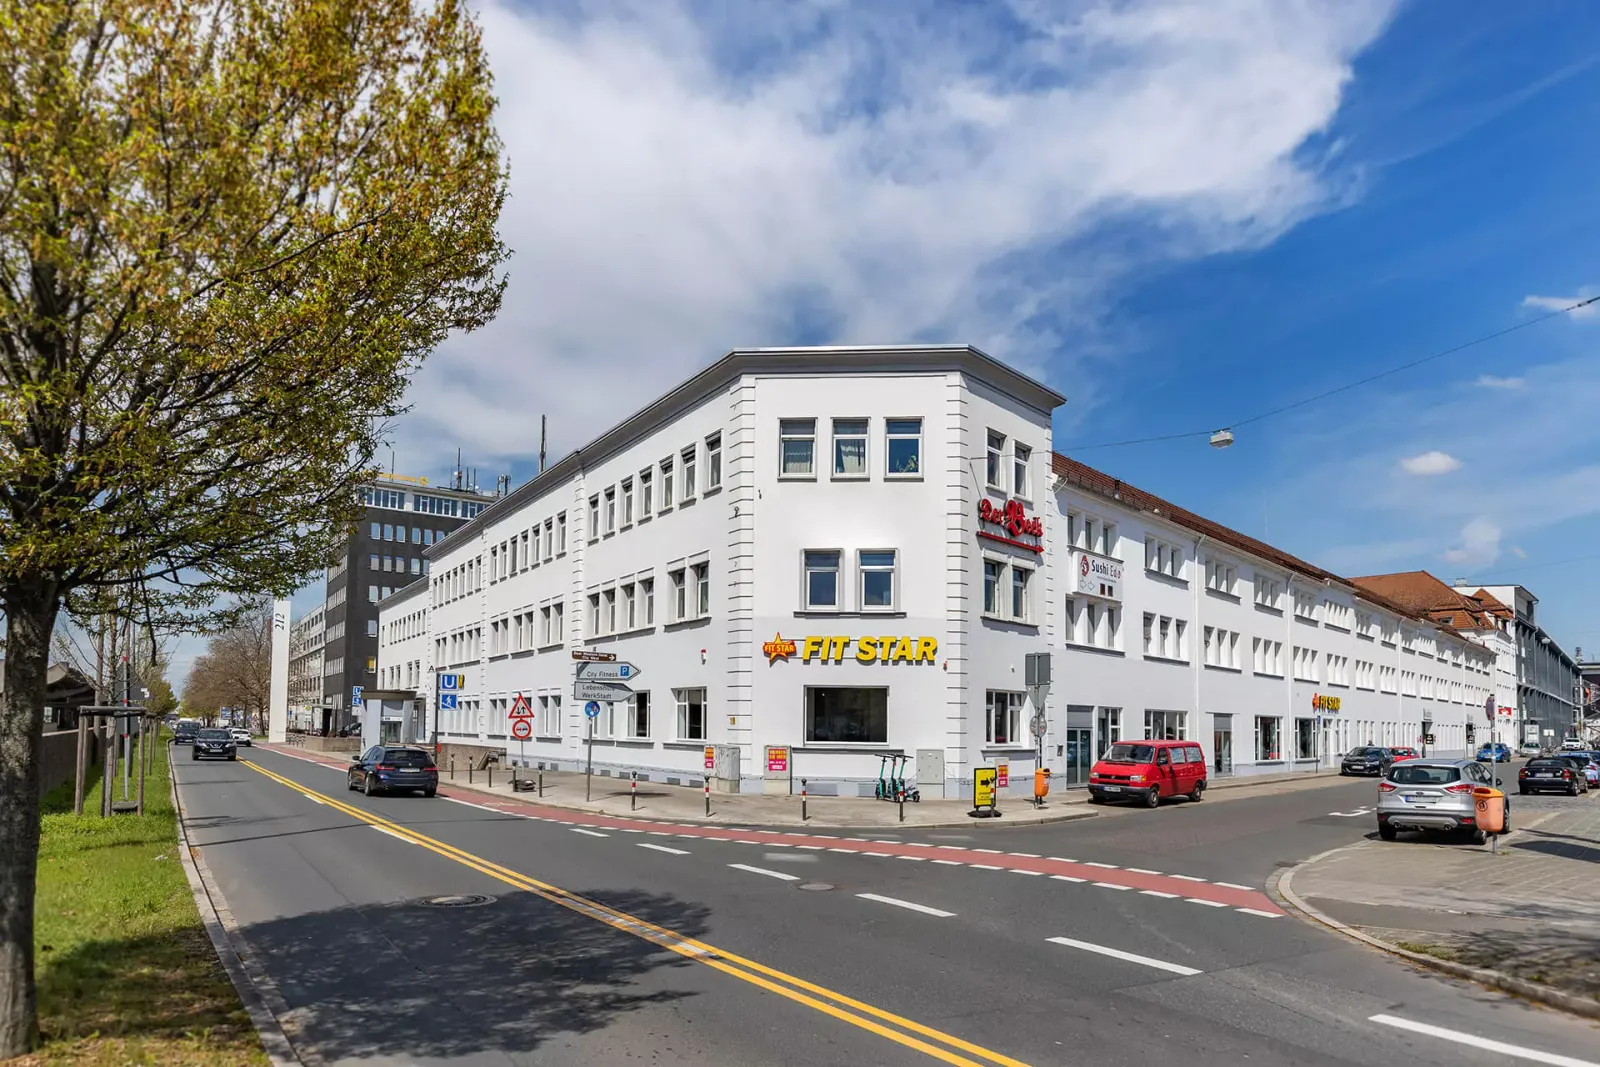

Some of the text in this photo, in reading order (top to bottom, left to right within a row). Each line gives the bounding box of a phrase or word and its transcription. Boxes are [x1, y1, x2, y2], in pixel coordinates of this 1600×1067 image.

[1091, 559, 1109, 576] Sushi
[764, 644, 795, 652] FIT STAR
[802, 636, 938, 663] FIT STAR
[444, 675, 455, 688] U
